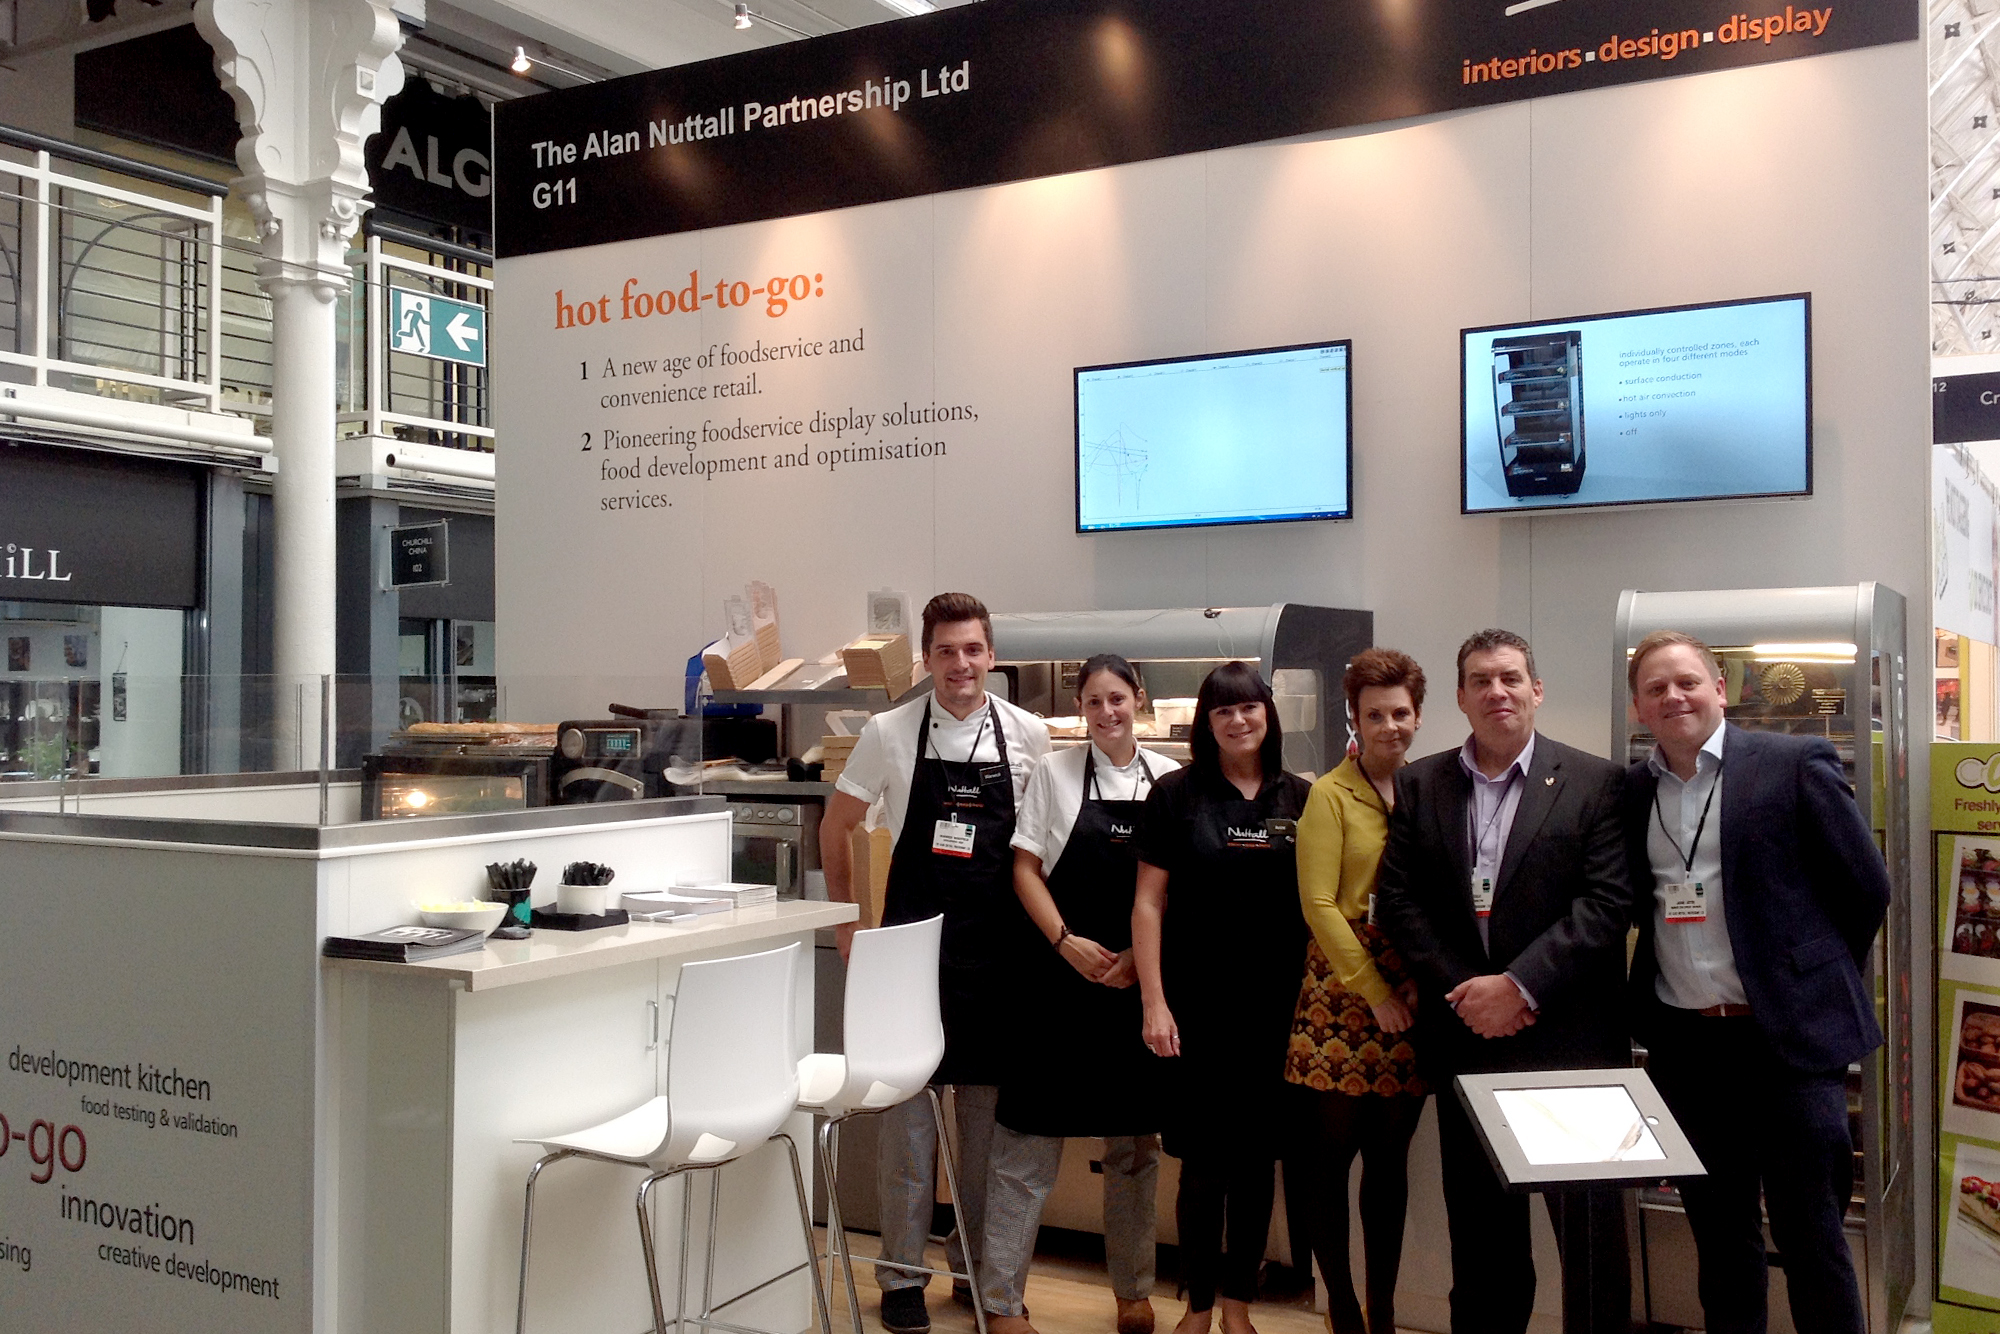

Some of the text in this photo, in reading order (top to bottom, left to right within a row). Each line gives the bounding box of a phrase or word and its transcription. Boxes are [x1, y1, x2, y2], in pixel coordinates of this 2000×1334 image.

[1462, 5, 1833, 85] interiors design display
[531, 60, 970, 169] The Alan Nuttall Partnership Ltd
[532, 176, 577, 209] G11
[554, 269, 824, 330] hot food-to-go:
[580, 327, 865, 381] 1 A new age of foodservice and
[1619, 358, 1650, 367] operate
[1662, 354, 1679, 363] four
[1681, 349, 1717, 361] different
[1719, 349, 1748, 358] modes
[1620, 348, 1665, 358] individually
[1667, 343, 1708, 354] controlled
[1739, 337, 1760, 348] each
[600, 371, 763, 409] convenience retail.
[1623, 395, 1637, 403] hot
[1651, 389, 1696, 401] convection
[1625, 372, 1702, 386] surface conduction
[580, 401, 980, 452] 2 Pioneering foodservice display solutions,
[1624, 408, 1667, 420] lights only
[1625, 427, 1638, 436] off
[600, 436, 948, 481] food development and optimisation
[600, 489, 673, 511] services.
[0, 542, 73, 581] iLL
[9, 1044, 211, 1101] development kitchen
[80, 1095, 238, 1138] food testing & validation
[61, 1184, 195, 1246] innovation
[98, 1242, 280, 1300] creative development
